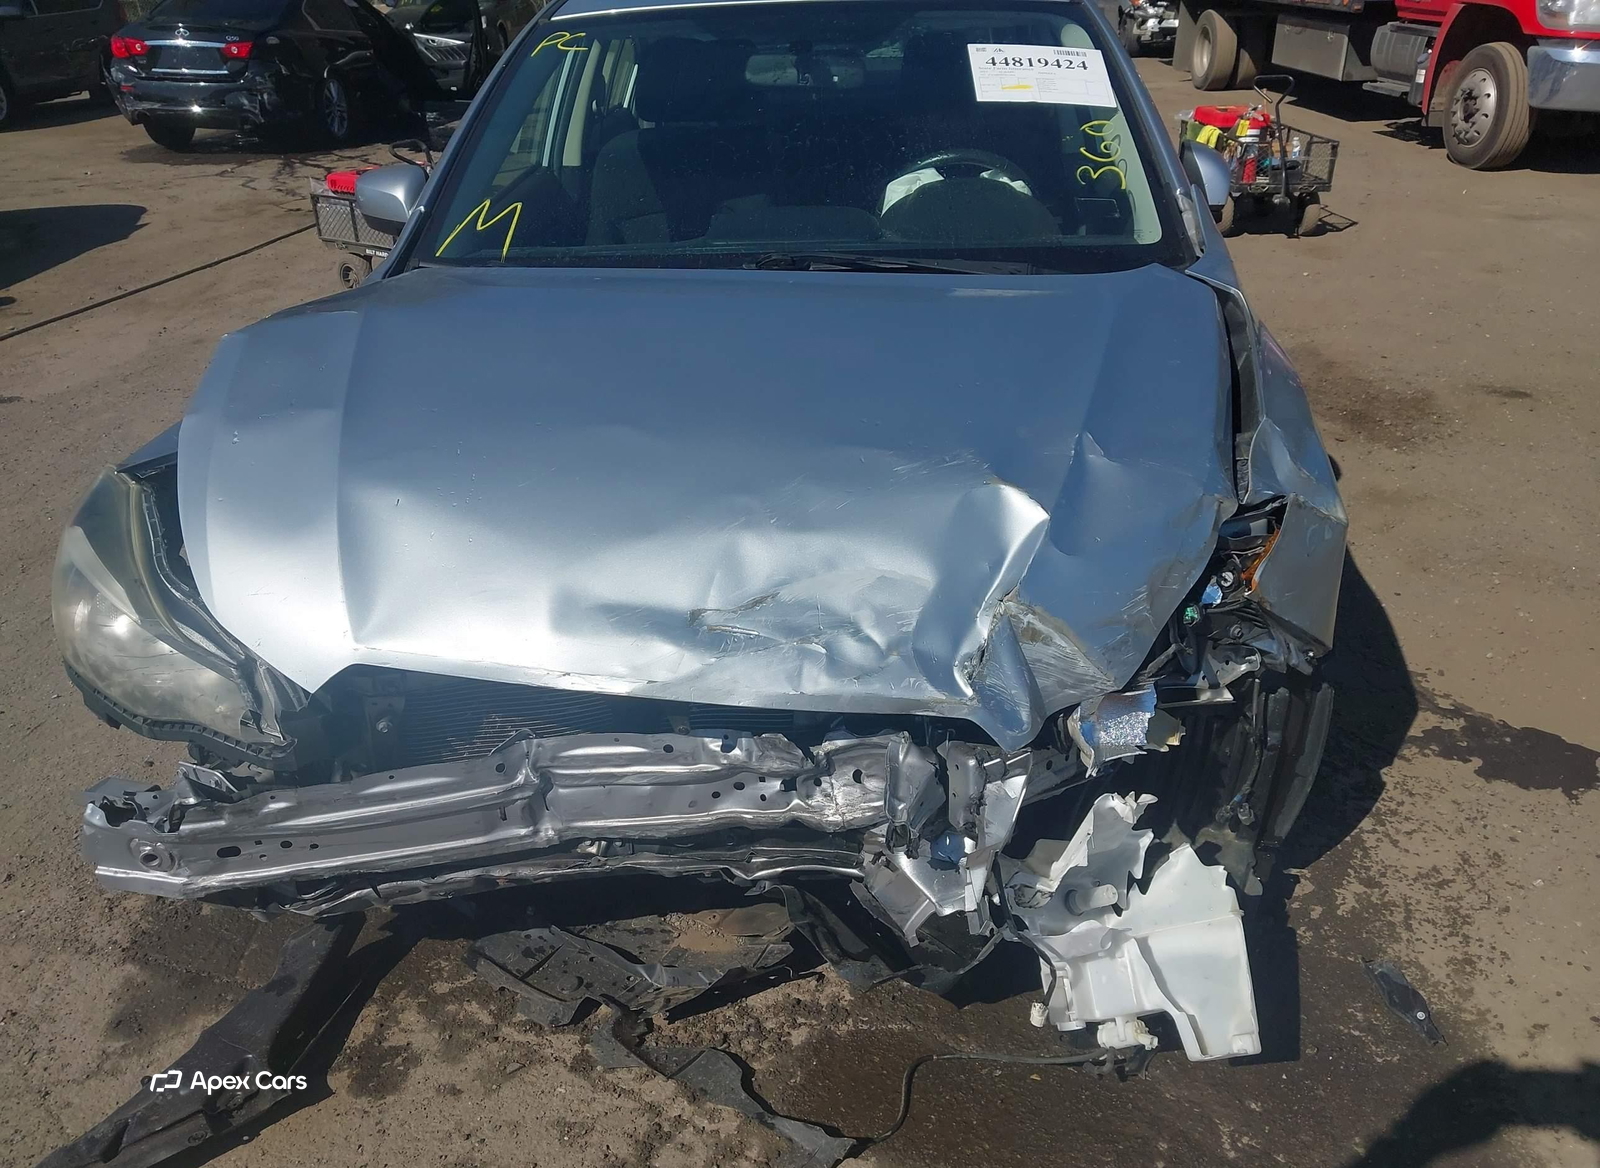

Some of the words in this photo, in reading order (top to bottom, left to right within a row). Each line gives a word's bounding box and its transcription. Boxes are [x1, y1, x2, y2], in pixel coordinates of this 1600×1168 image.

[531, 31, 589, 57] PC
[986, 56, 1088, 70] 44819424
[1076, 120, 1126, 190] 360
[435, 199, 523, 263] M
